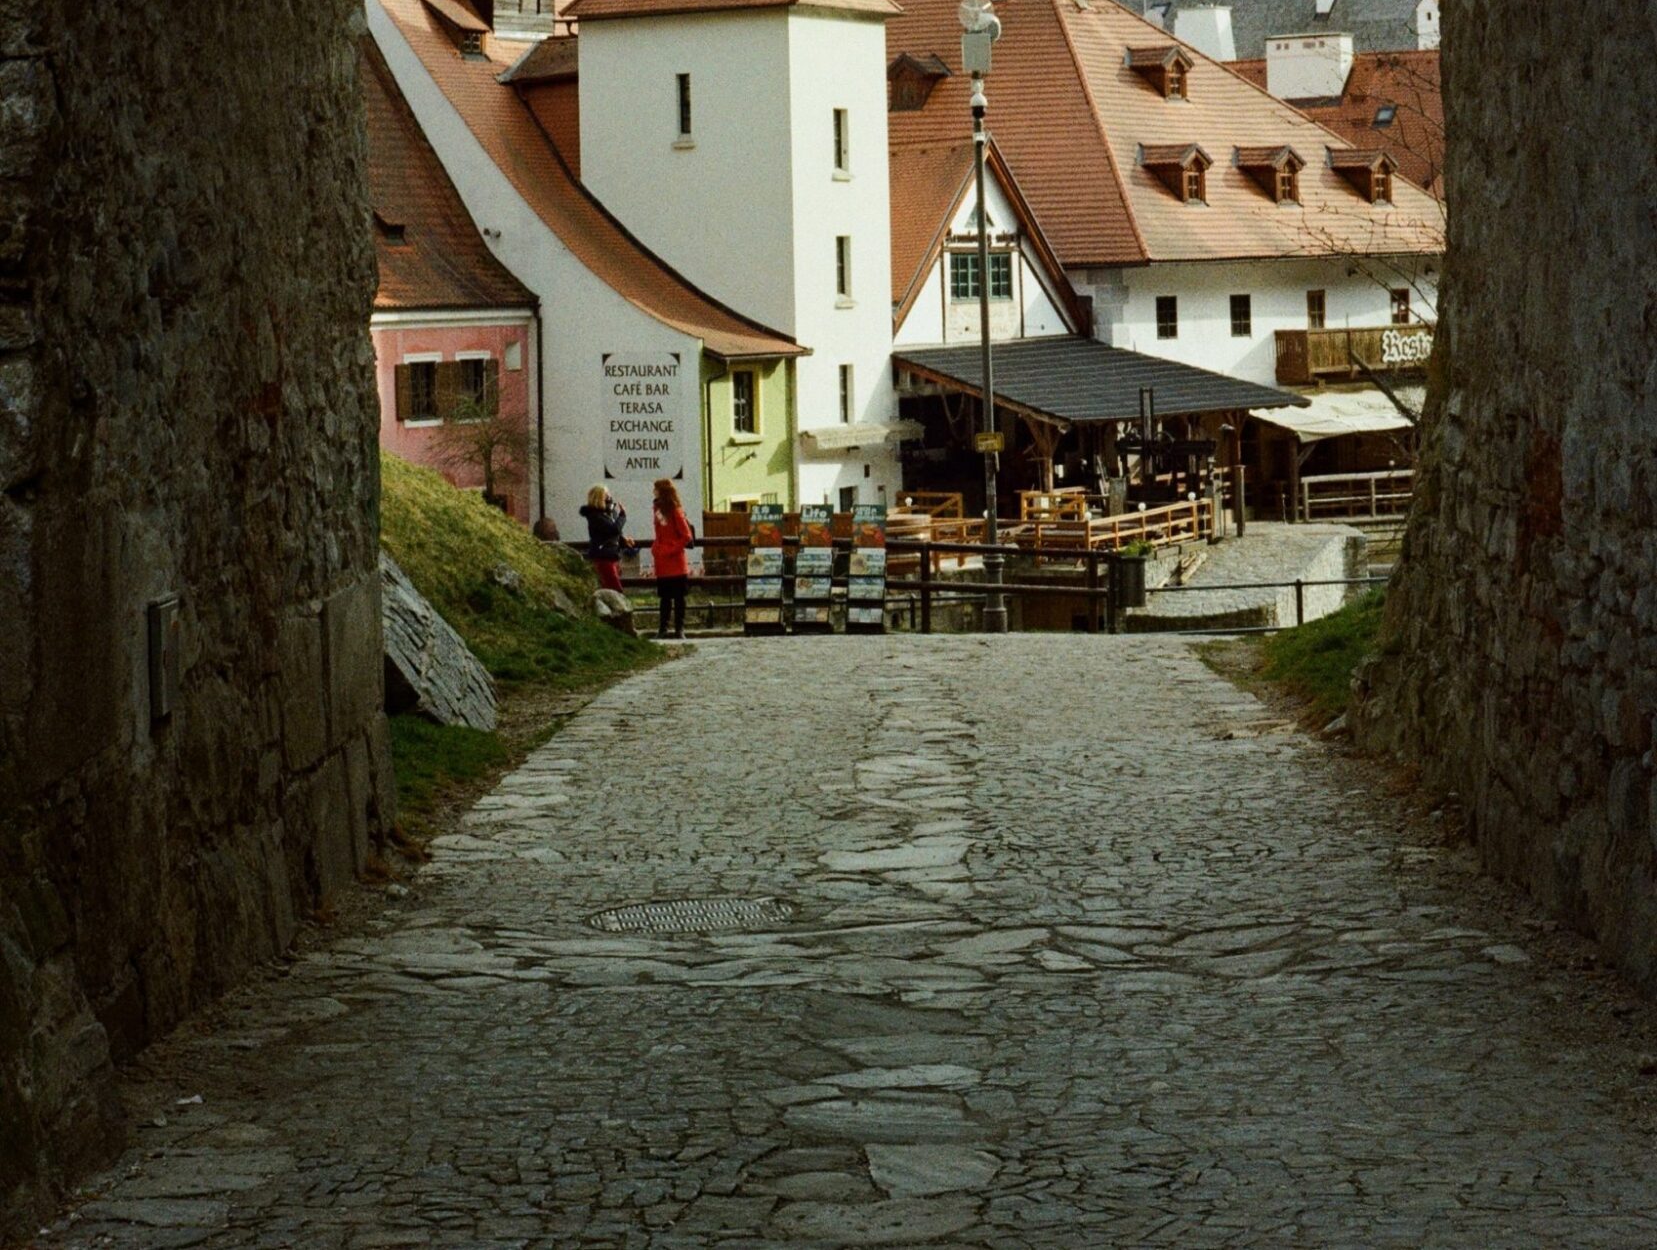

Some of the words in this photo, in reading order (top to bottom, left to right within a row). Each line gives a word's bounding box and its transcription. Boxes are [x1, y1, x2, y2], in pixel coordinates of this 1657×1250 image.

[604, 364, 677, 377] RESTAURANT
[613, 381, 642, 396] CAFÉ
[646, 383, 669, 396] BAR
[619, 402, 663, 414] TERASA
[610, 420, 674, 433] EXCHANGE
[616, 439, 669, 451] MUSEUM
[625, 457, 660, 469] ANTIK
